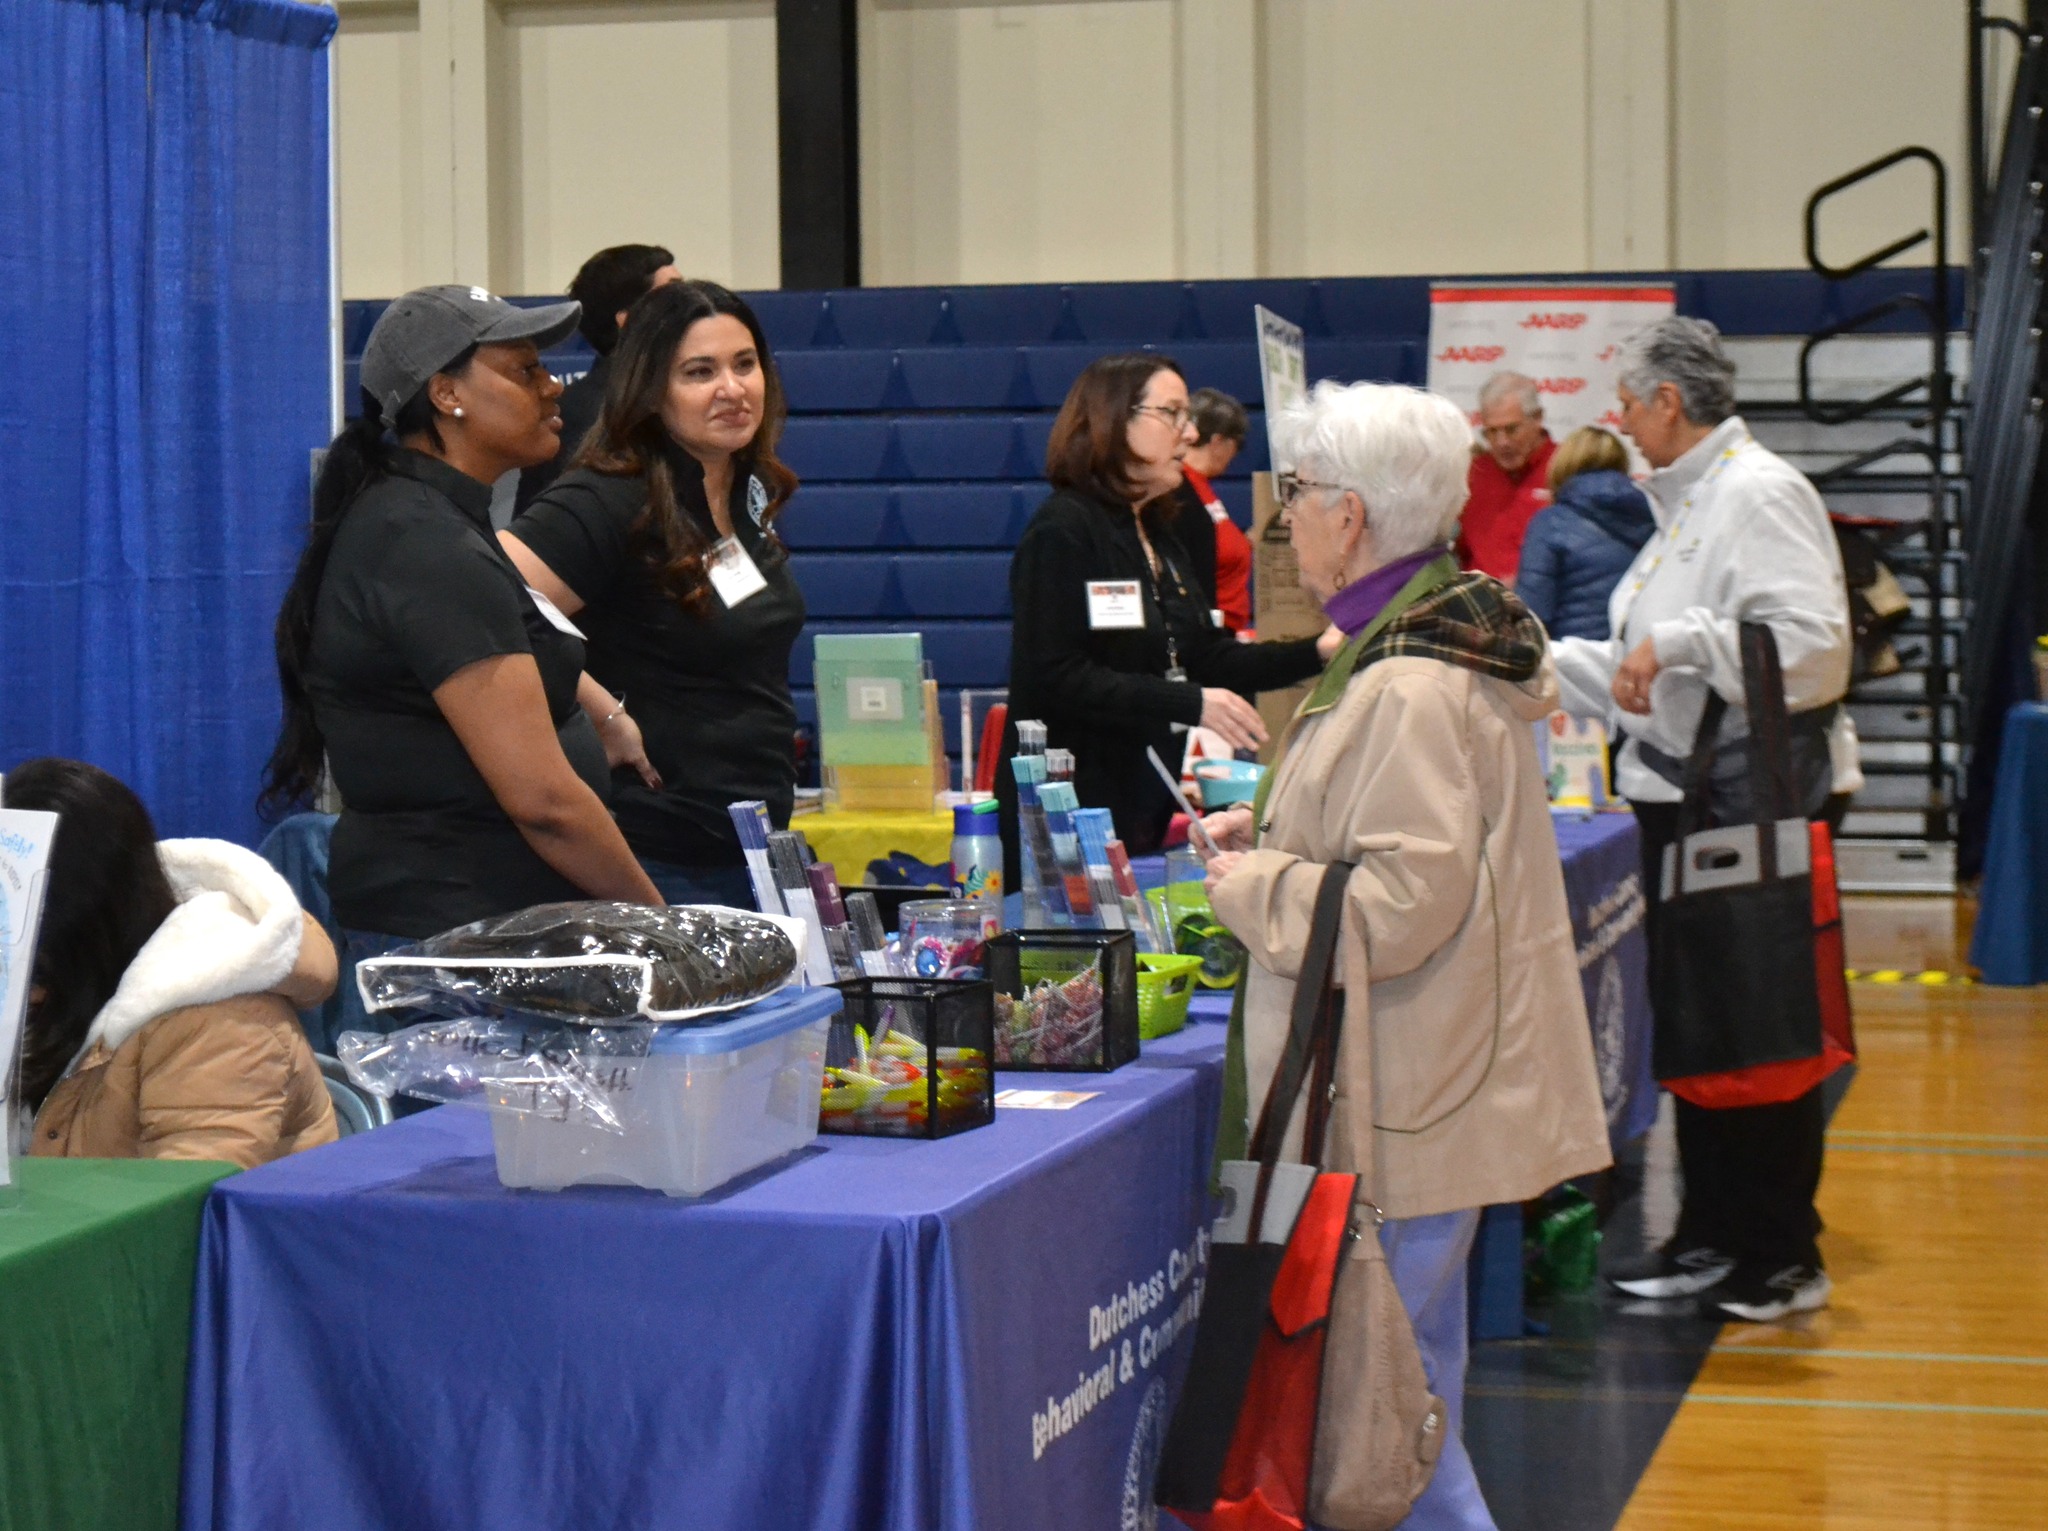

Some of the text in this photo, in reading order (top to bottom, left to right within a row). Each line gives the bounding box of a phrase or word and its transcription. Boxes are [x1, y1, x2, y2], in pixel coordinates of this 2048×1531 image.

[1089, 1270, 1165, 1351] Dutchess
[1032, 1349, 1116, 1462] Behavioral
[1119, 1338, 1135, 1384] &
